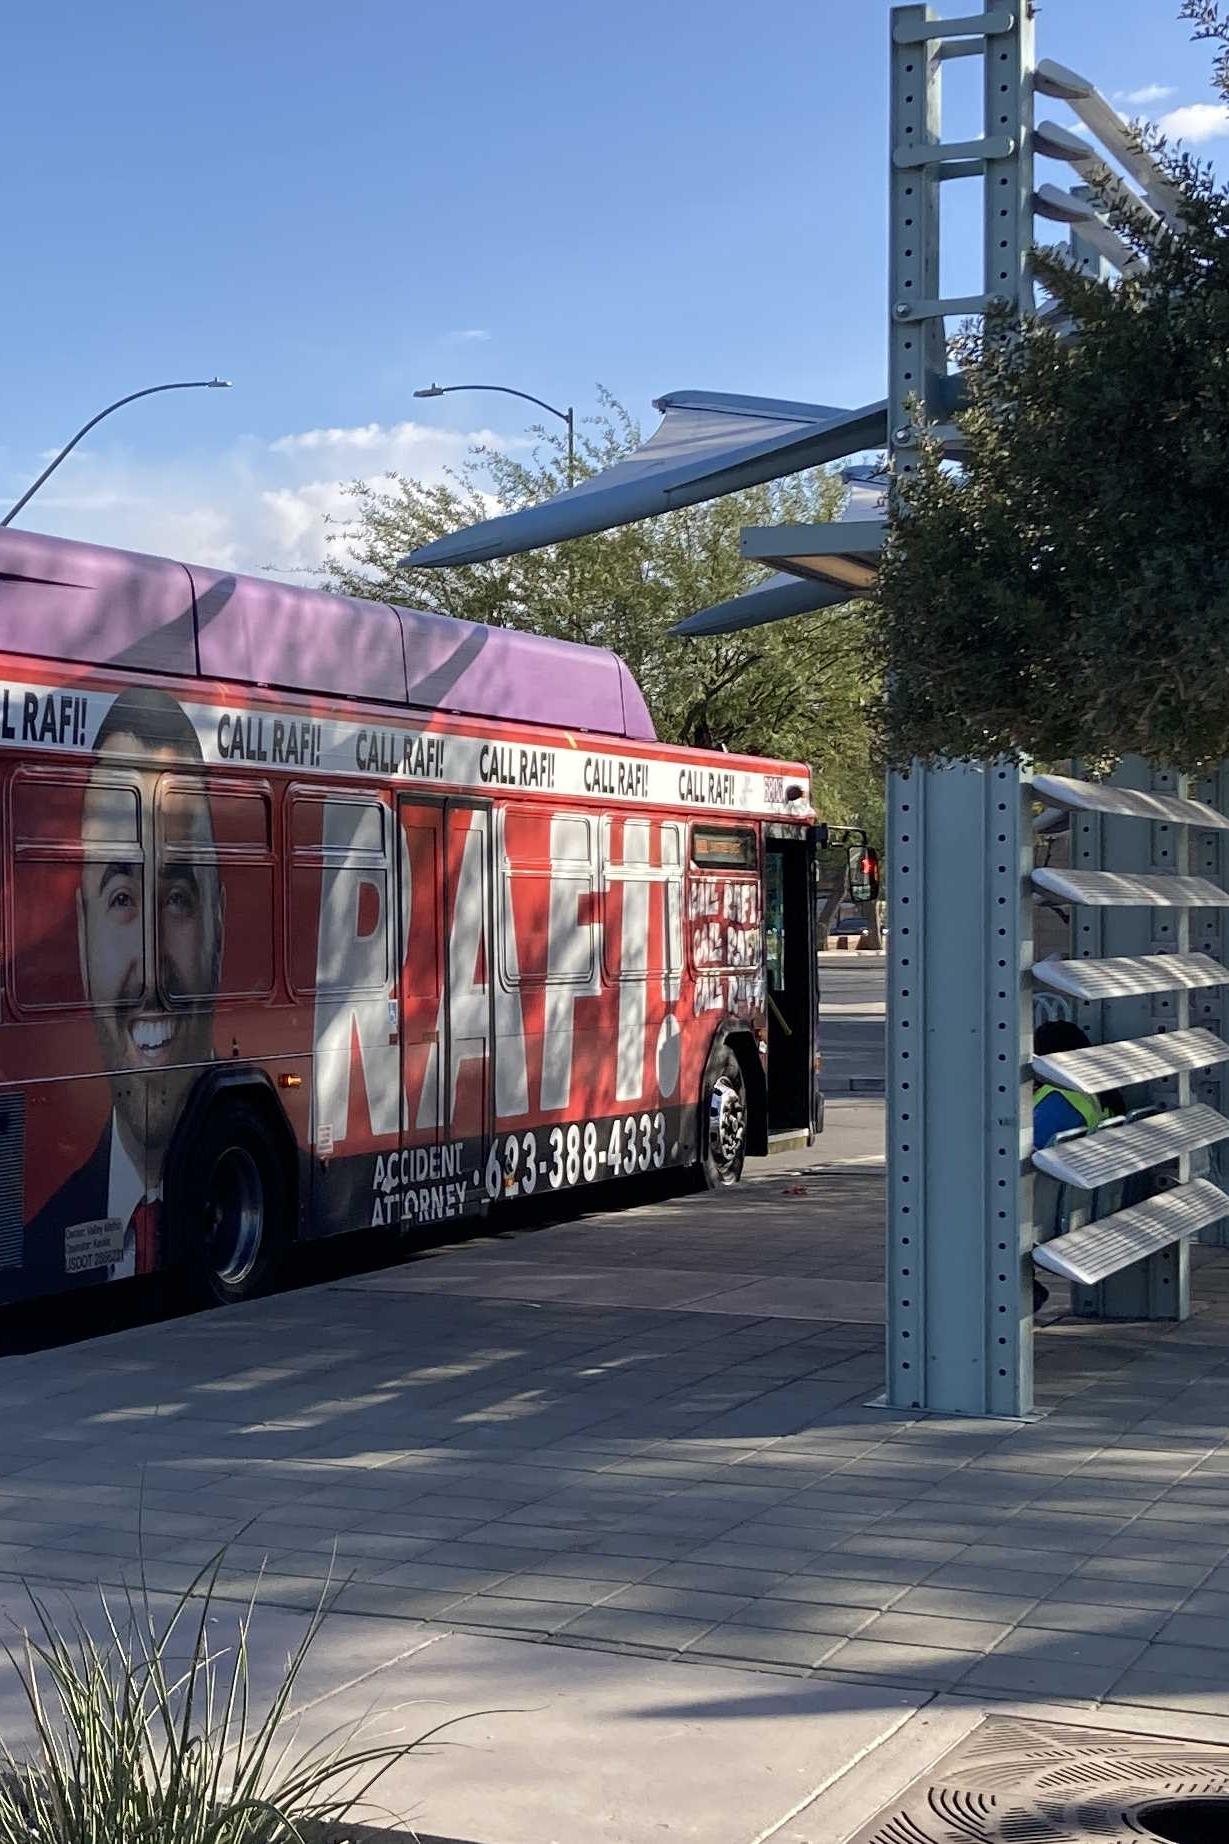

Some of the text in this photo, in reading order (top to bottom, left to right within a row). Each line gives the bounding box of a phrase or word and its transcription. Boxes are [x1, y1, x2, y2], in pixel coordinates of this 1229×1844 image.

[22, 691, 88, 747] RAFI!
[217, 713, 322, 767] CALL RAFI!
[356, 730, 445, 779] CALL RAFI!
[479, 744, 556, 788] CALL RAFI!
[583, 757, 650, 799] CALL RAFI!
[678, 769, 735, 805] CALL RAFI!
[309, 797, 682, 1144] RAFI!
[373, 1142, 465, 1194] ACCIDENT
[484, 1111, 667, 1203] 623-388-4333
[371, 1180, 468, 1227] ATTORNEY
